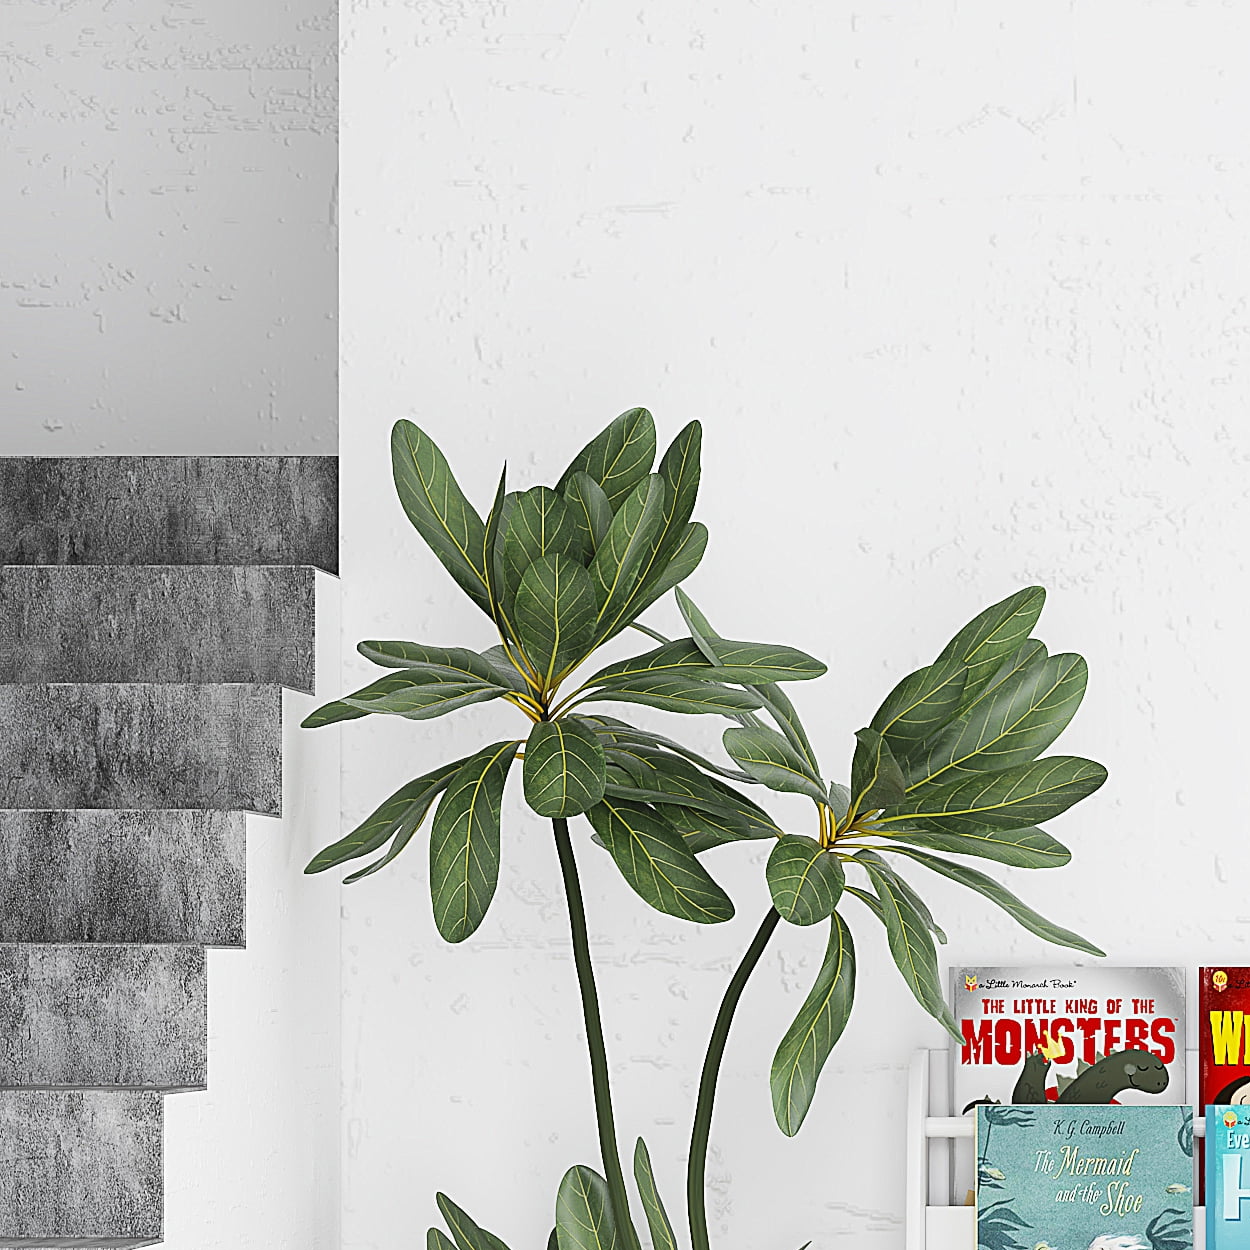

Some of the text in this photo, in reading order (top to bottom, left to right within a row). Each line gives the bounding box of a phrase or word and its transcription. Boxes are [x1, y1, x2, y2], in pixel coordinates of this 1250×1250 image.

[986, 979, 1010, 989] Little
[1011, 979, 1048, 989] Monarch
[1049, 979, 1074, 989] Book
[981, 998, 1155, 1015] THE LITTLE KING OF THE
[961, 1017, 1176, 1066] MONSTERS
[1079, 1119, 1126, 1140] Campbell
[1034, 1145, 1140, 1180] The Mermaid
[1055, 1180, 1143, 1218] and the Shoe
